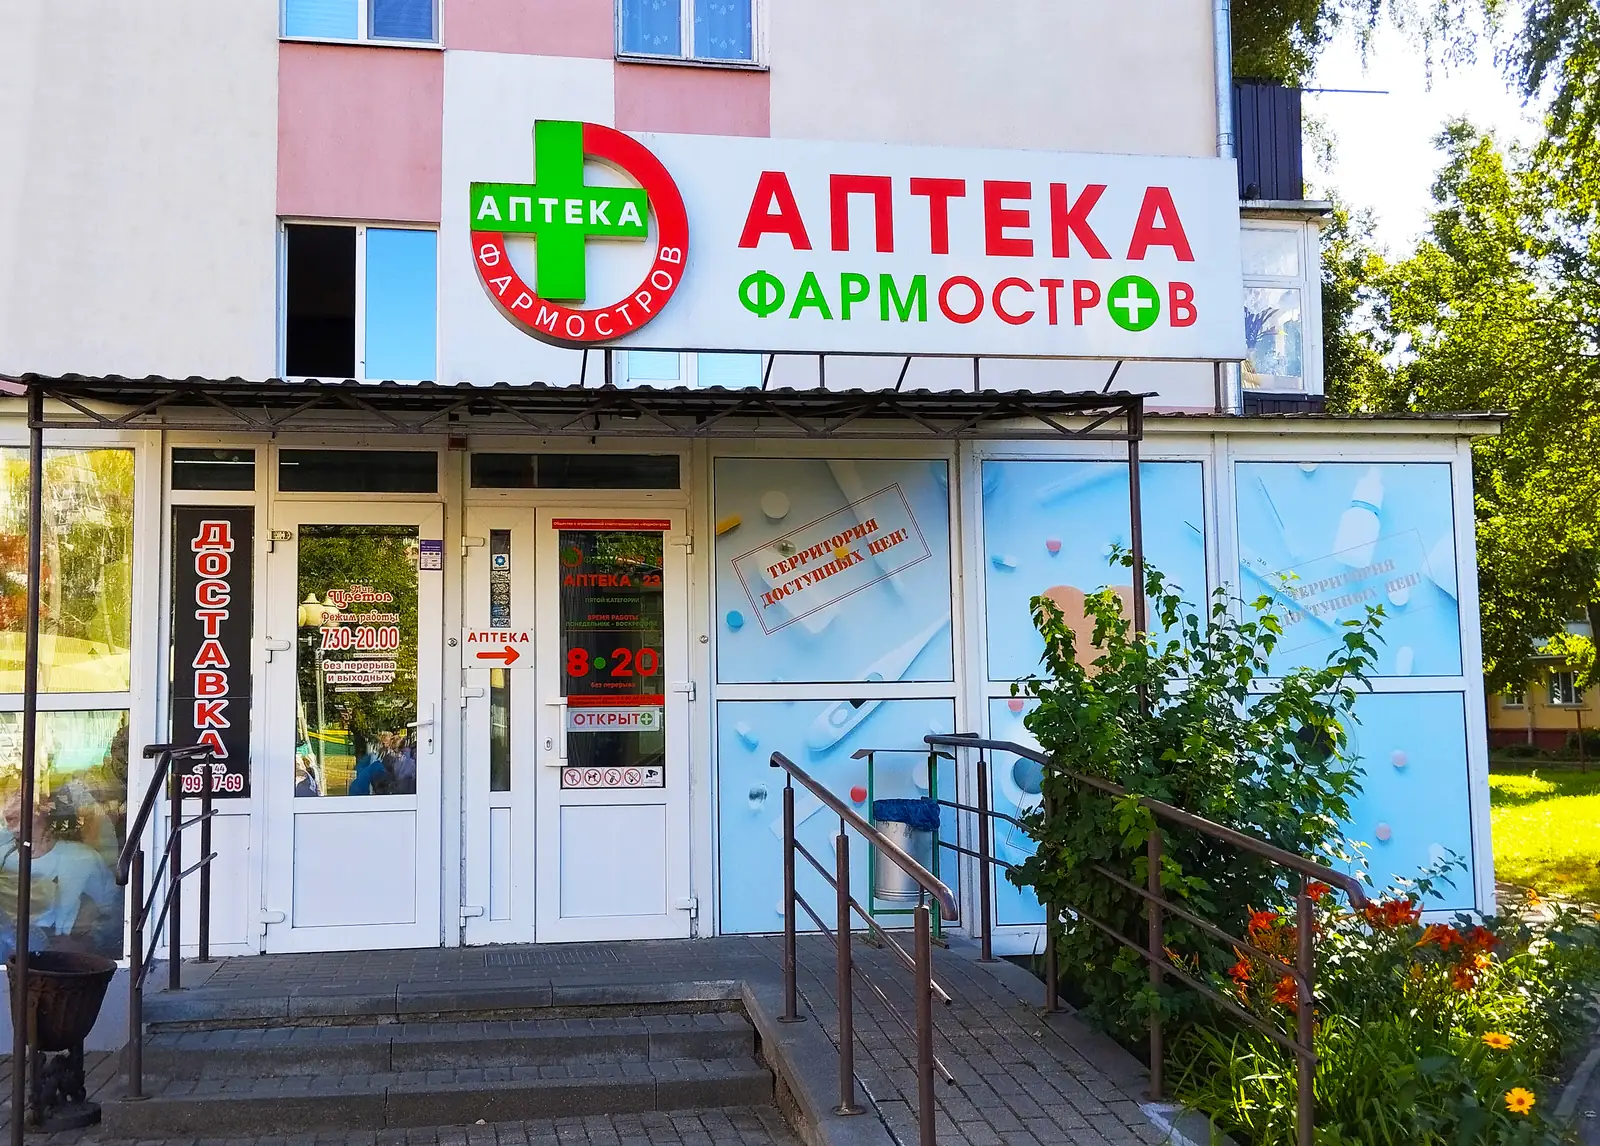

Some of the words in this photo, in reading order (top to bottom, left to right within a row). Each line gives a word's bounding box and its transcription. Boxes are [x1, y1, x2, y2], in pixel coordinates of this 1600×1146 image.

[477, 195, 643, 228] АПТЕКА
[737, 170, 1195, 261] АПТЕКА
[479, 243, 682, 338] ФАРМОСТРОВ
[767, 517, 879, 579] ТЕРРИТОРИЯ
[760, 549, 865, 609] ДОСТУПНЫХ
[867, 527, 909, 556] ЦЕН!
[351, 585, 374, 594] Мир
[564, 574, 631, 587] АПТЕКА
[643, 575, 660, 587] 23
[328, 590, 392, 608] Цветов
[321, 612, 357, 624] Режим
[360, 610, 399, 624] работы
[191, 520, 235, 759] ДОСТАВКА
[321, 627, 398, 649] 7.30-20.00
[468, 632, 529, 643] АПТЕКА
[323, 660, 341, 670] без
[343, 661, 396, 672] перерыва
[327, 674, 335, 682] и
[337, 674, 391, 683] выходных
